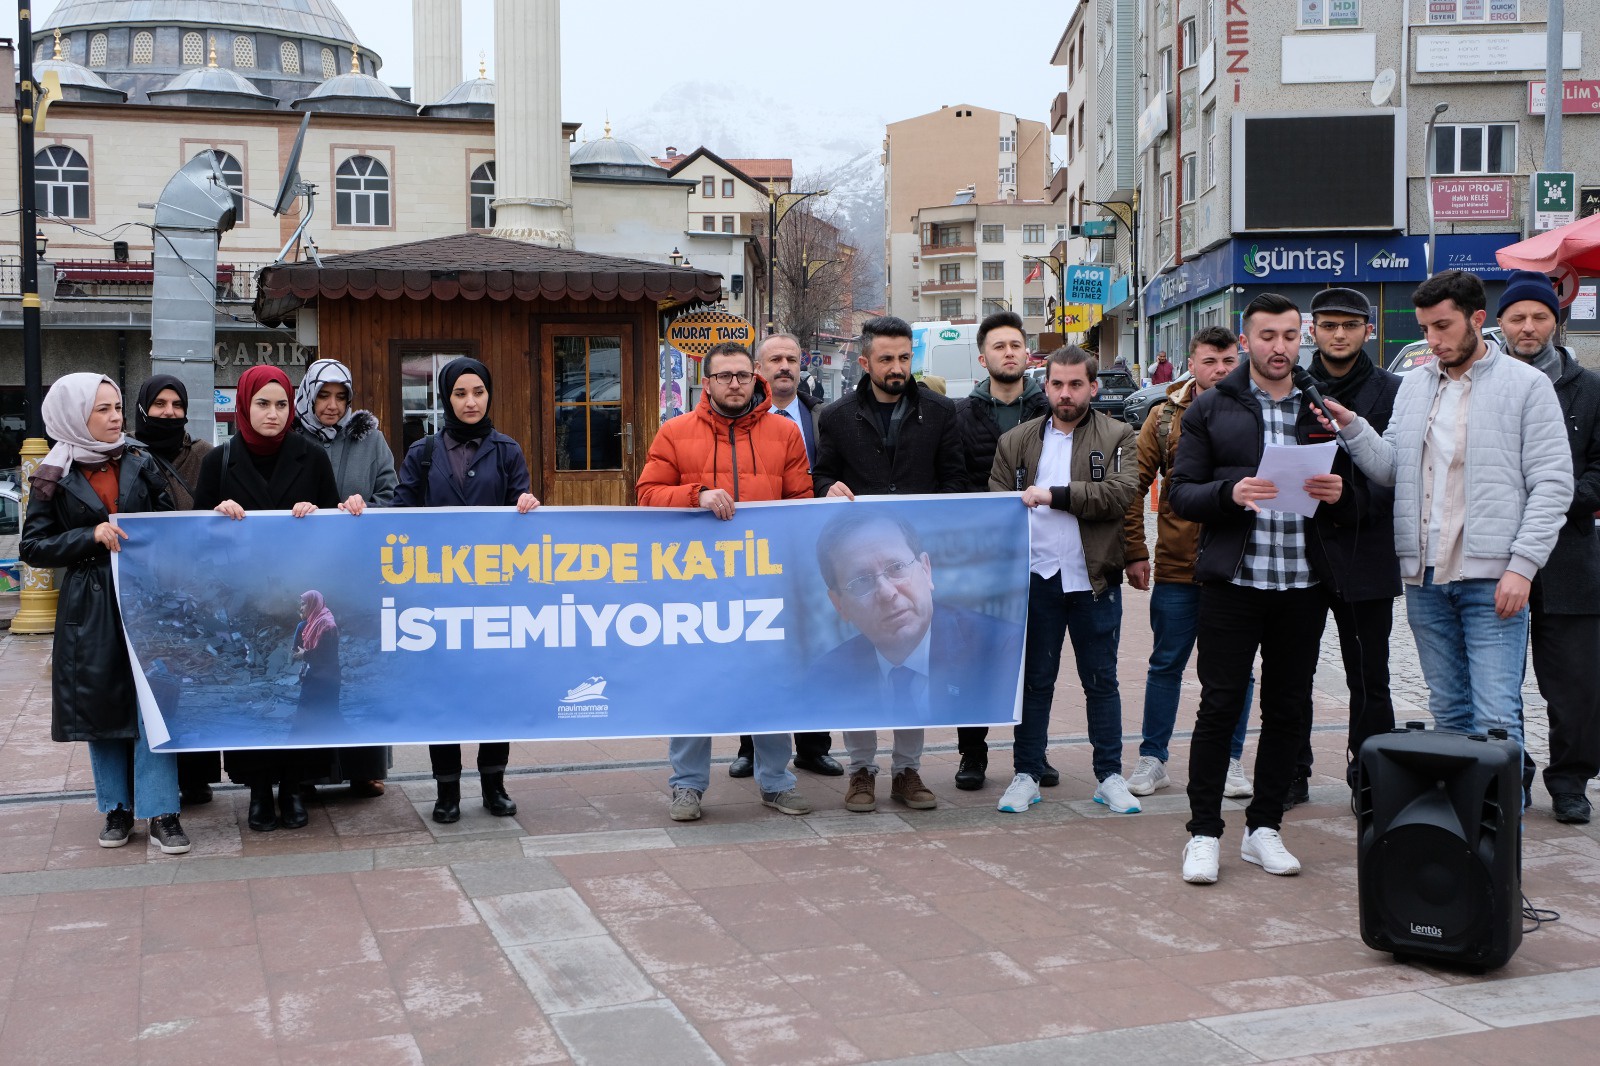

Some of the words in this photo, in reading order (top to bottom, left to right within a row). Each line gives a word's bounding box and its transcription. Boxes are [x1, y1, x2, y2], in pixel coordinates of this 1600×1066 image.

[1333, 2, 1356, 10] HDI
[1438, 184, 1465, 193] PLAN
[1468, 183, 1503, 192] PROJE
[1470, 194, 1489, 203] KELEŞ
[1254, 246, 1345, 277] güntaş
[1448, 254, 1472, 262] 7/24
[1072, 279, 1103, 287] HARCA
[1072, 285, 1102, 294] HARCA
[1071, 291, 1102, 300] BİTMEZ
[671, 326, 712, 340] MURAT
[715, 324, 749, 340] TAKSİ
[214, 341, 306, 370] ÇARIK
[1089, 450, 1106, 483] 6
[379, 534, 642, 586] ÜLKEMİZDE
[651, 529, 784, 581] KATİL
[380, 593, 786, 652] İSTEMİYORUZ
